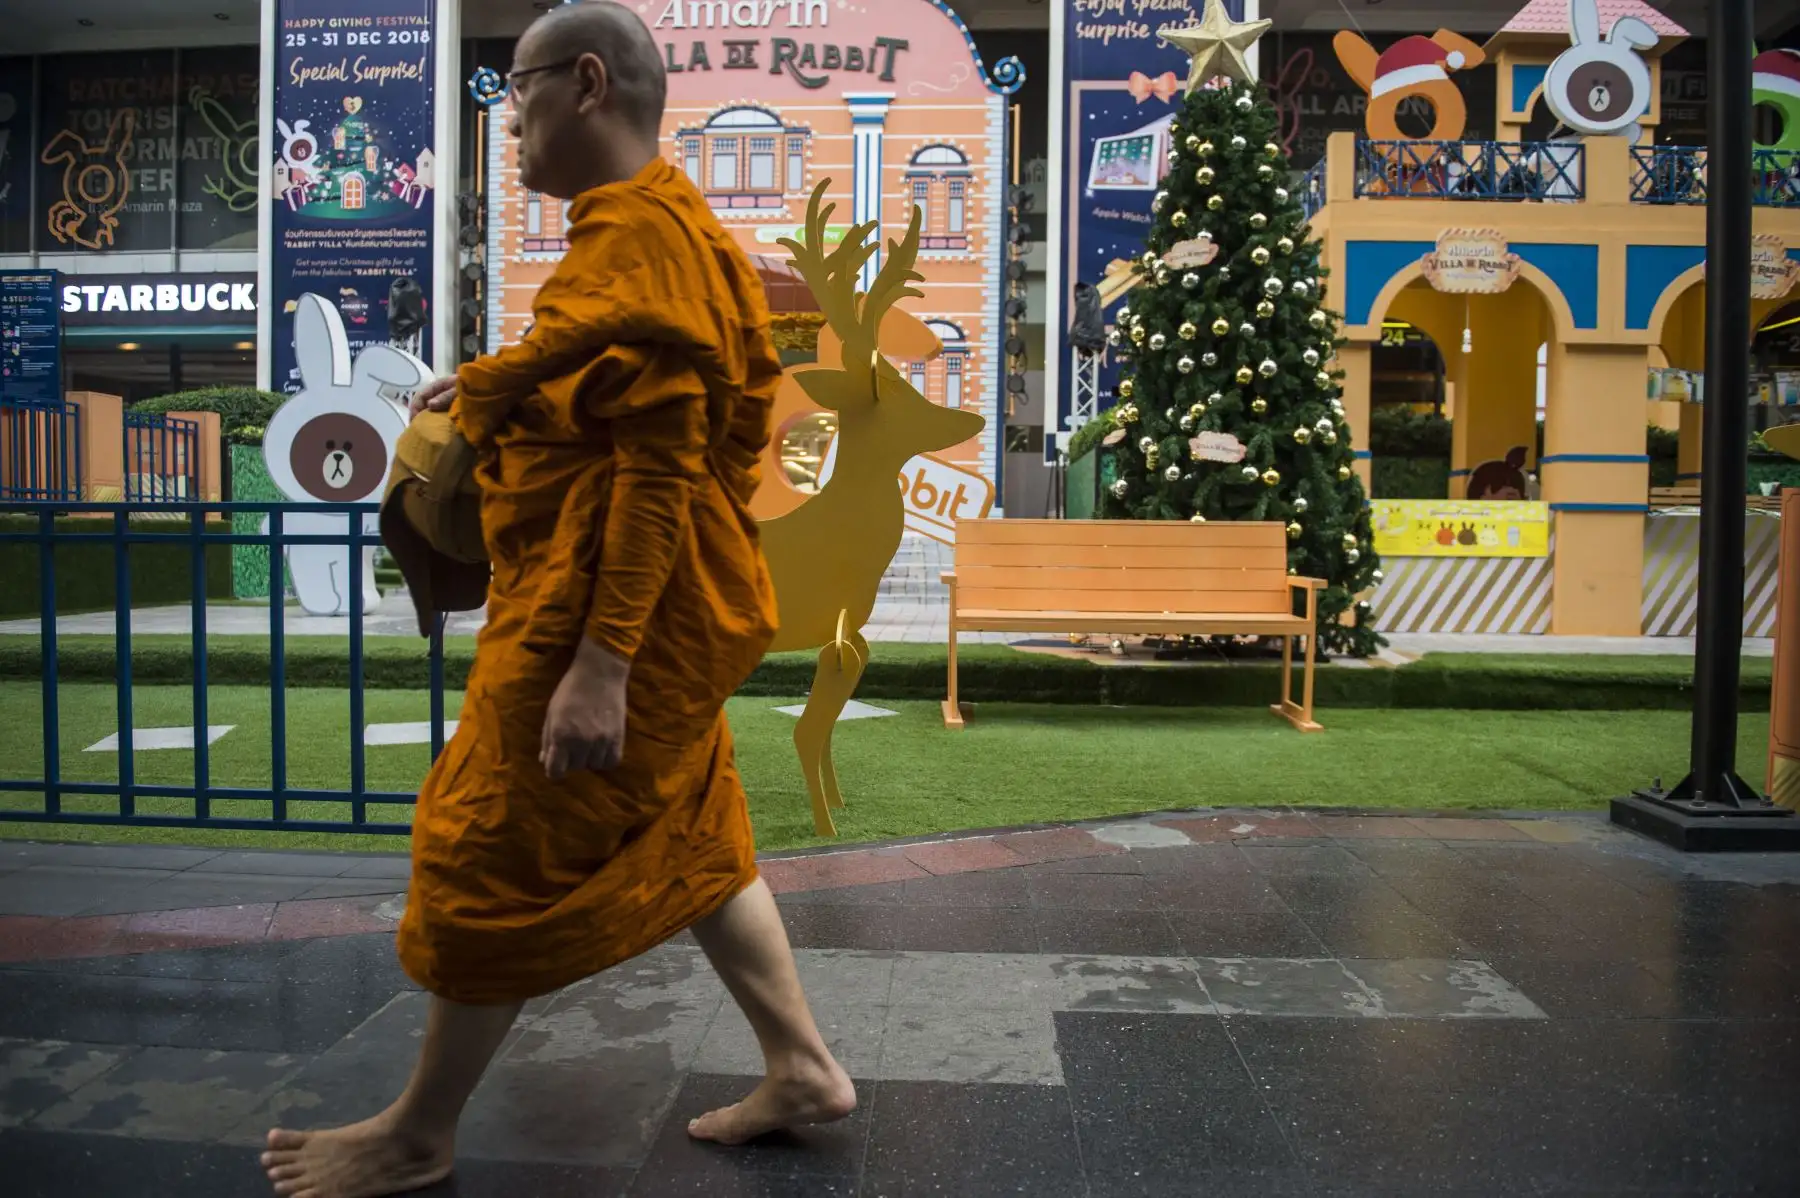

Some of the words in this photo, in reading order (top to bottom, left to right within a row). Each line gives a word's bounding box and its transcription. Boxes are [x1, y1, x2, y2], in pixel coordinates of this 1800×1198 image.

[285, 18, 325, 29] HAPPY
[329, 16, 372, 28] GIVING
[376, 15, 430, 27] FESTIVAL
[653, 0, 828, 28] Amarin
[285, 33, 306, 47] 25
[322, 32, 338, 46] 31
[346, 31, 381, 46] DEC
[387, 30, 431, 44] 2018
[1076, 20, 1150, 46] surprise
[723, 40, 760, 69] DE
[289, 56, 349, 88] Special
[352, 54, 426, 87] Surprise!
[61, 283, 258, 313] STARBUCK
[897, 468, 969, 520] bit
